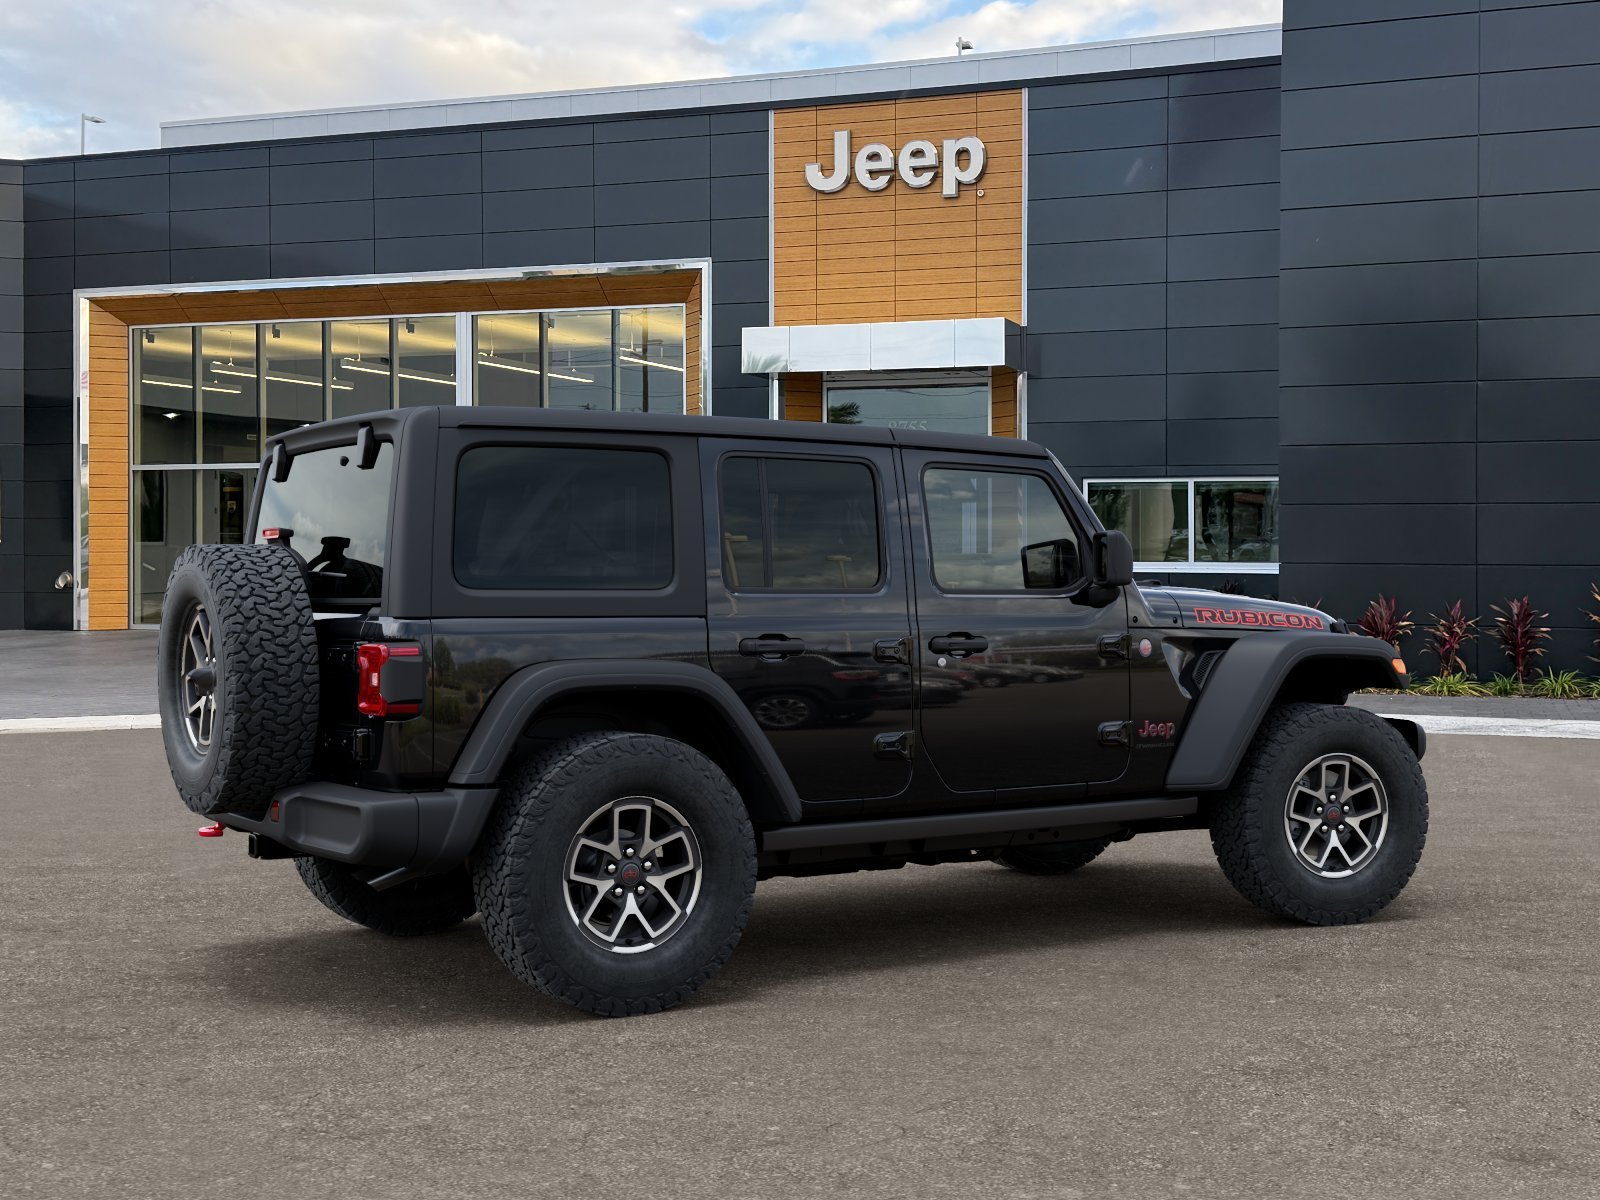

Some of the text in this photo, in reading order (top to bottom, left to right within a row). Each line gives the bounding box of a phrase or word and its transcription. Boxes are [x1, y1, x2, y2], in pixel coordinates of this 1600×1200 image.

[805, 129, 987, 198] Jeep
[1194, 607, 1324, 630] RUBICON
[1138, 720, 1175, 739] Jeep
